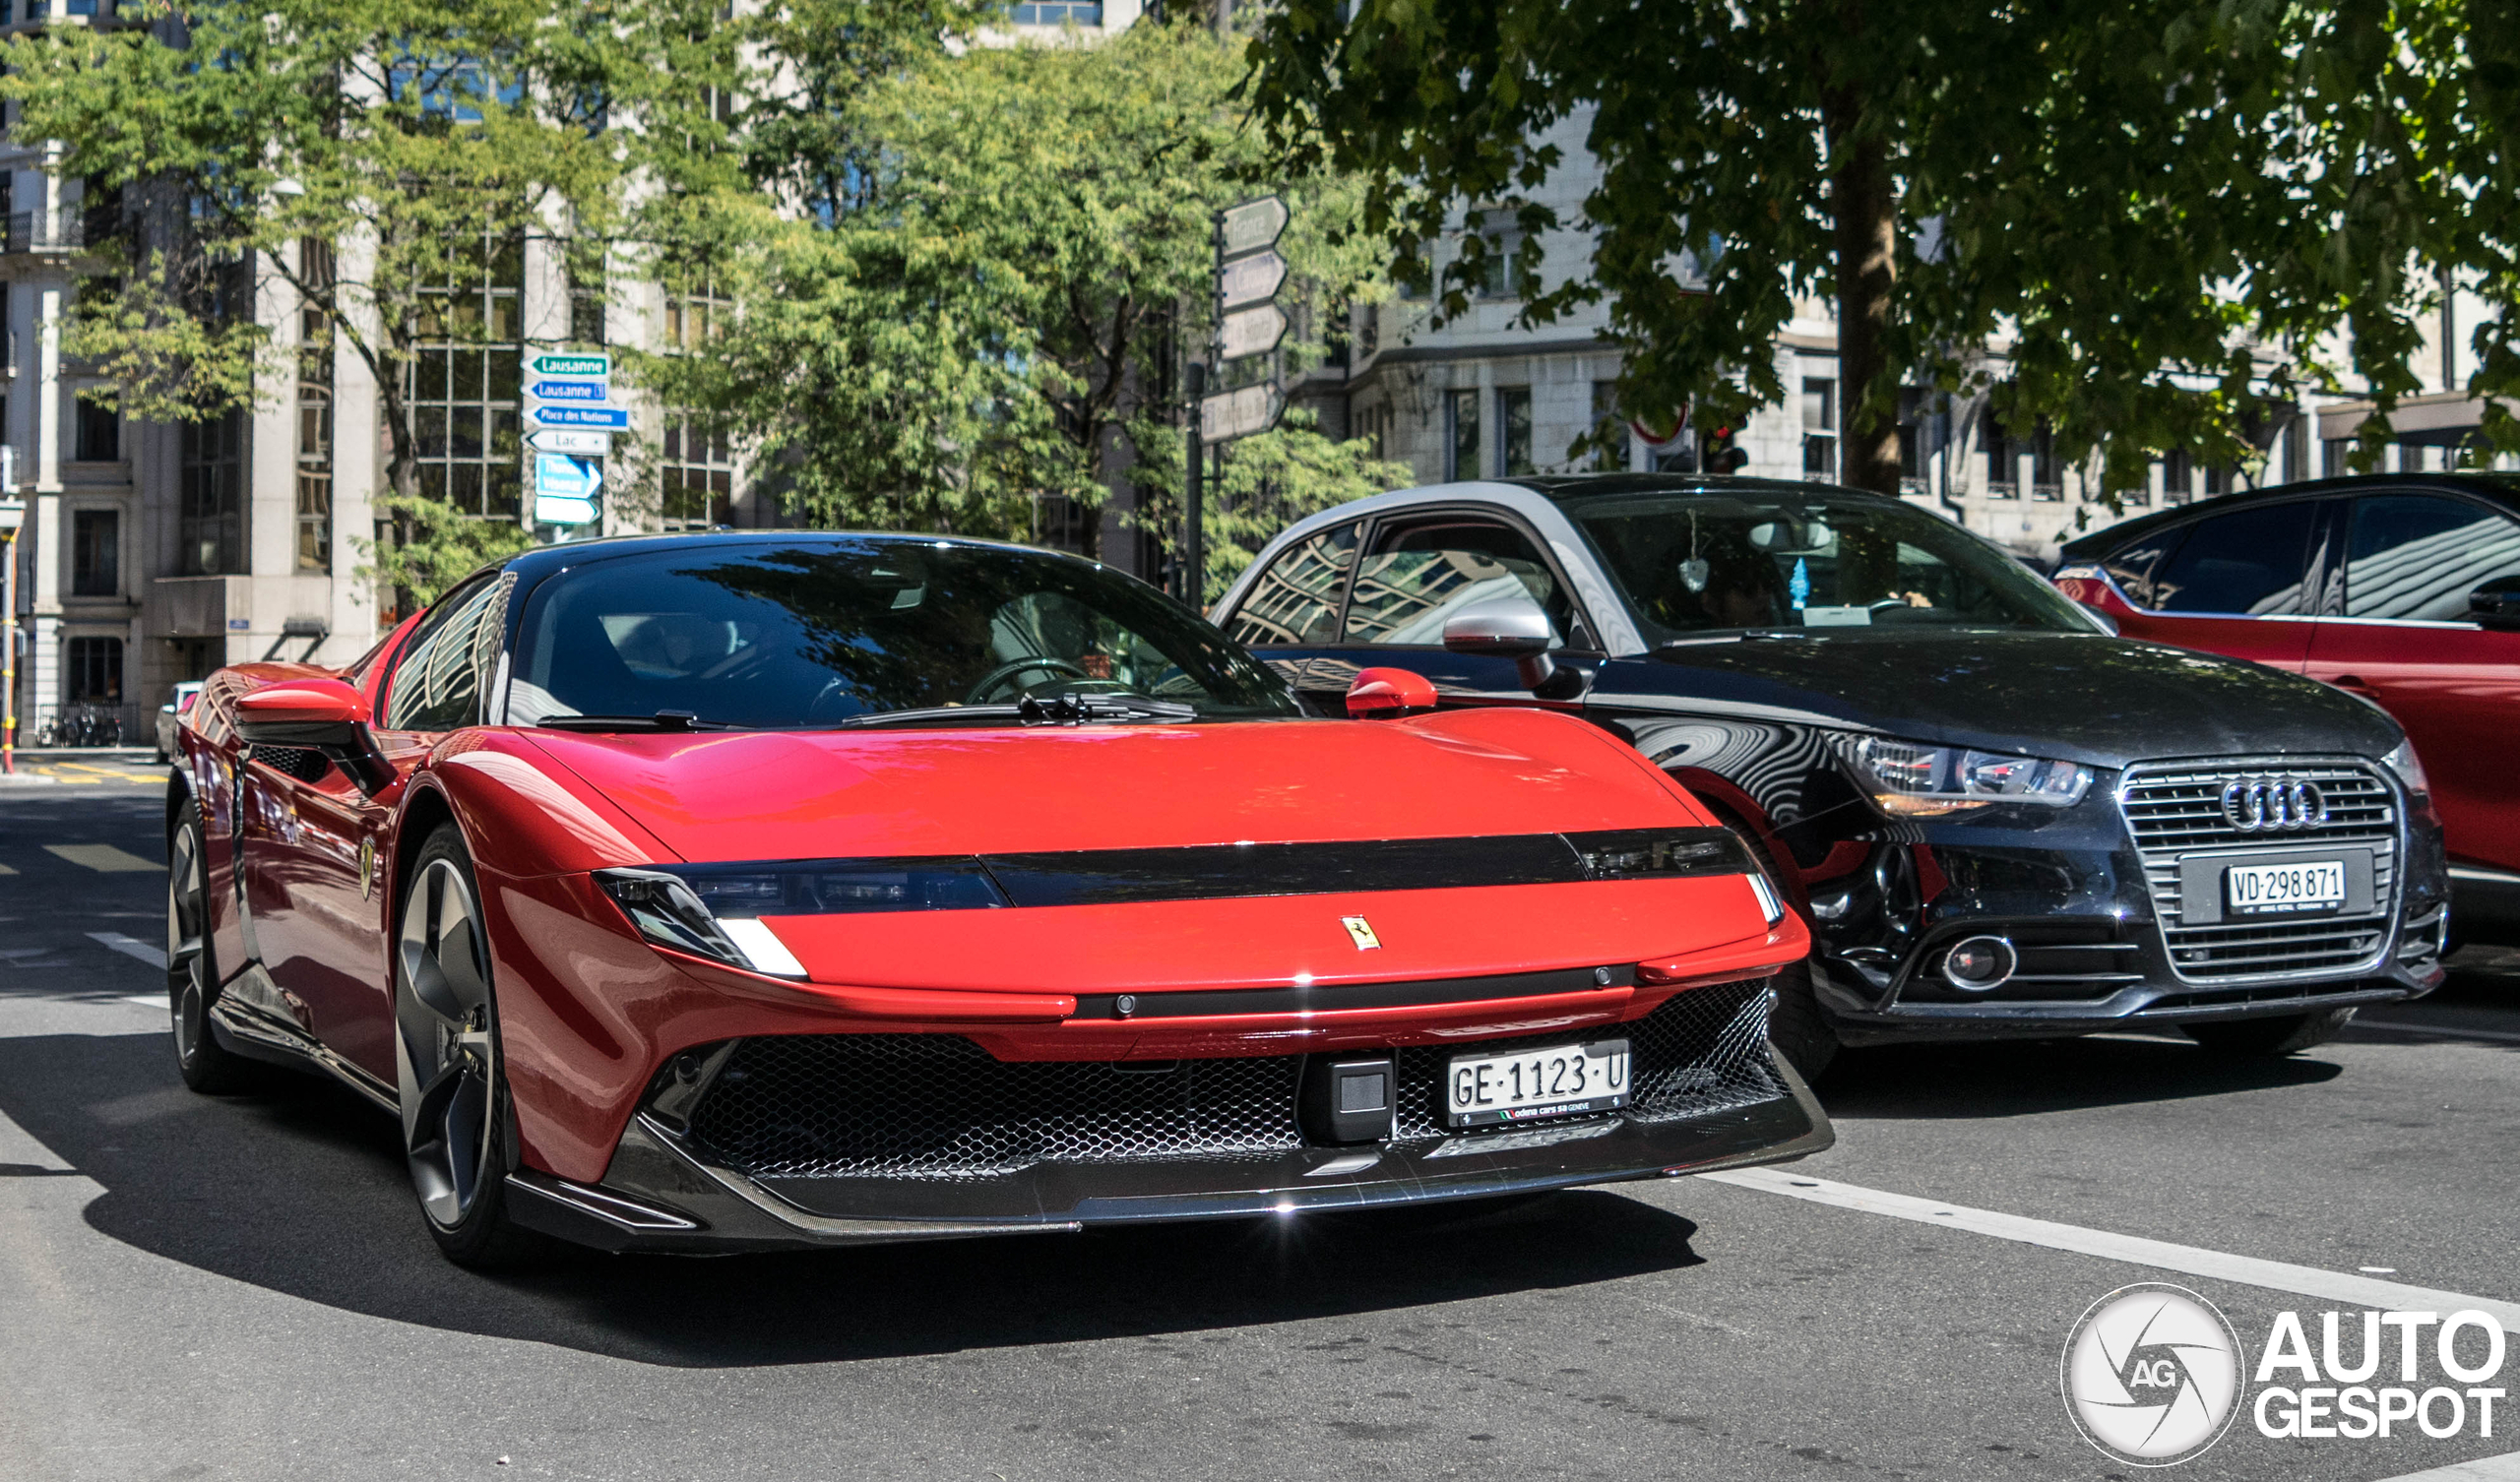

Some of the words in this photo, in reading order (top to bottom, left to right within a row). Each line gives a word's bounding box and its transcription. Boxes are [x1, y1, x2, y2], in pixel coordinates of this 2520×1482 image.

[542, 358, 602, 373] Lausanne
[539, 383, 591, 398] Lausanne
[541, 409, 563, 421] Place
[565, 410, 579, 421] des
[581, 411, 612, 423] Nations
[555, 434, 577, 447] Lac
[1539, 1105, 1556, 1115] cars
[1557, 1104, 1567, 1113] sa
